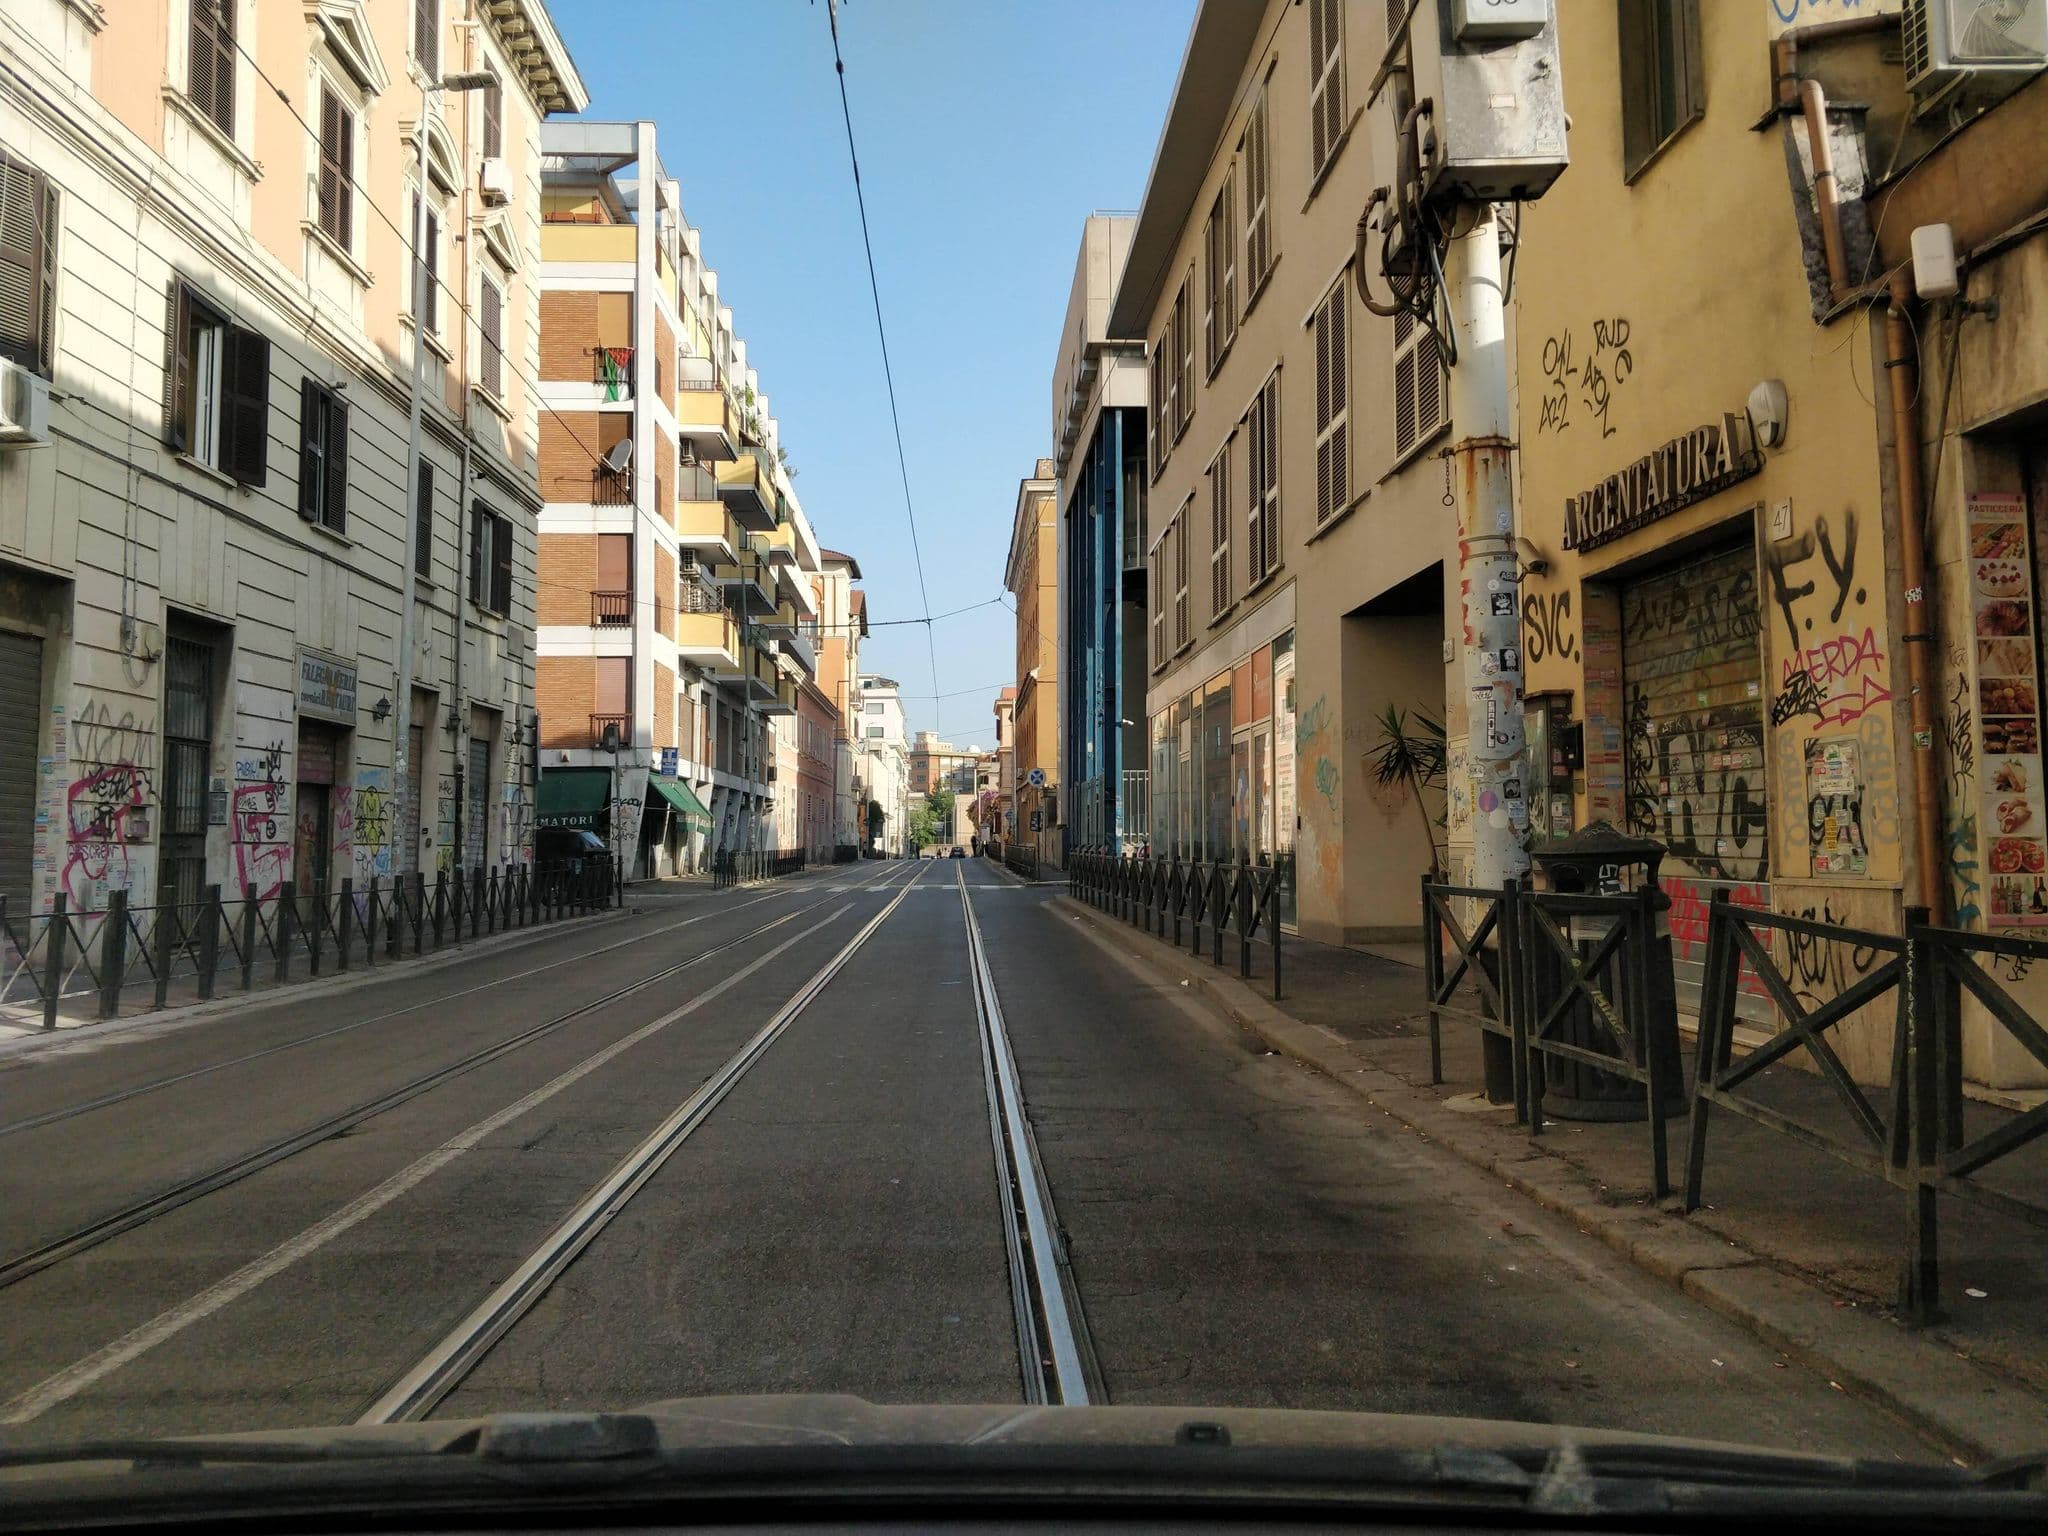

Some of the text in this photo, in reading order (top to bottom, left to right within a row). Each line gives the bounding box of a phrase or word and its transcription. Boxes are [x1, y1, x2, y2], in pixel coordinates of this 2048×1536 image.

[1562, 412, 1739, 551] ARGENTATURA
[1773, 504, 1789, 532] 47
[1968, 504, 2024, 513] PASTICCERIA
[1783, 626, 1885, 690] MERDA
